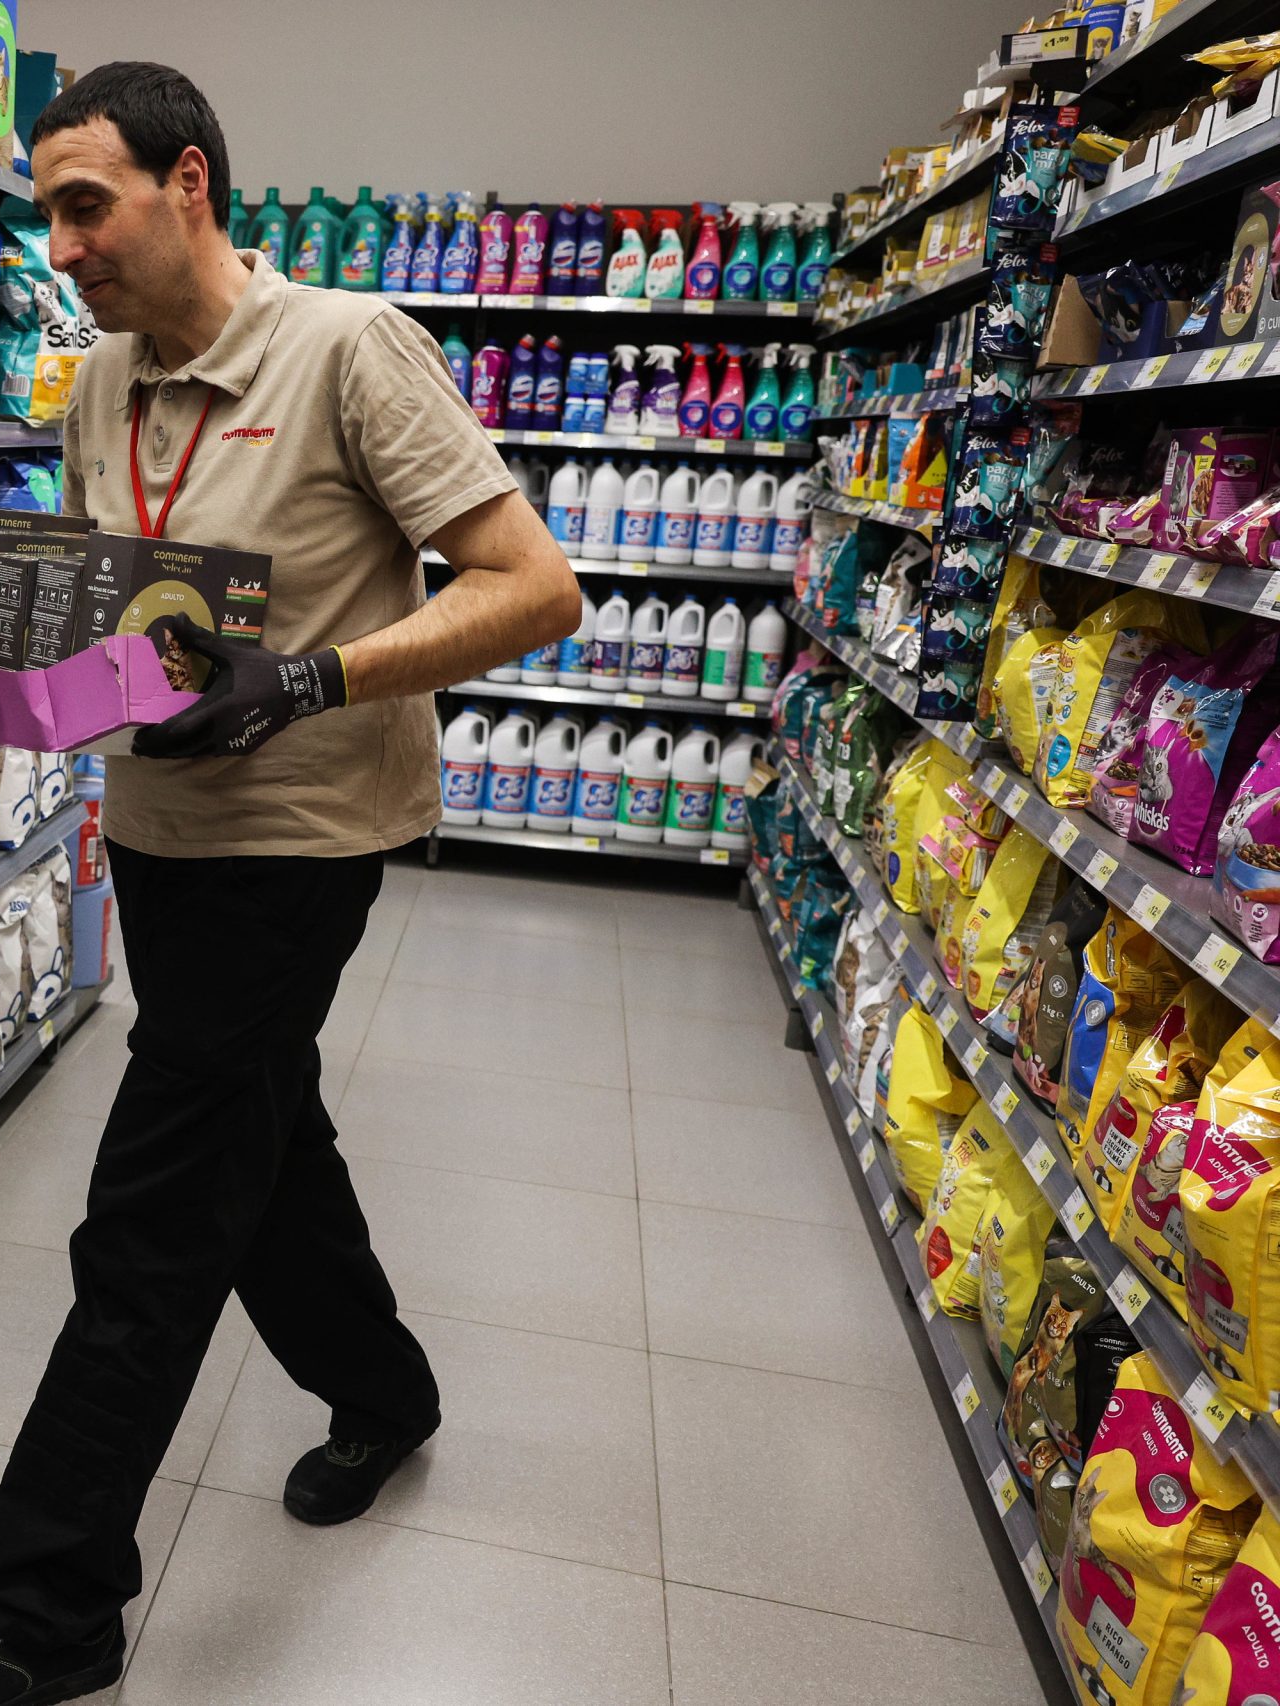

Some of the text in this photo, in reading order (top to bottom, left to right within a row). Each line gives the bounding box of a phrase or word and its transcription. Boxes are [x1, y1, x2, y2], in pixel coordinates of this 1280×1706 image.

[1010, 120, 1046, 140] felix
[996, 253, 1028, 271] felix
[967, 436, 998, 451] felix
[16, 543, 65, 554] CONTINENTE
[153, 550, 204, 565] CONTINENTE
[95, 574, 114, 582] ADULTO
[229, 577, 239, 587] X3
[160, 592, 185, 602] ADULTO
[228, 718, 269, 749] HyFlex
[1134, 801, 1170, 832] whiskas
[1048, 1005, 1057, 1018] kg
[1071, 1274, 1096, 1295] ADULTO
[1151, 1400, 1188, 1463] CONTINENTE
[1142, 1430, 1159, 1456] ADULTO
[1105, 1621, 1124, 1646] RICO
[1092, 1623, 1130, 1671] EM FRANGO
[1241, 1625, 1270, 1670] ADULTO
